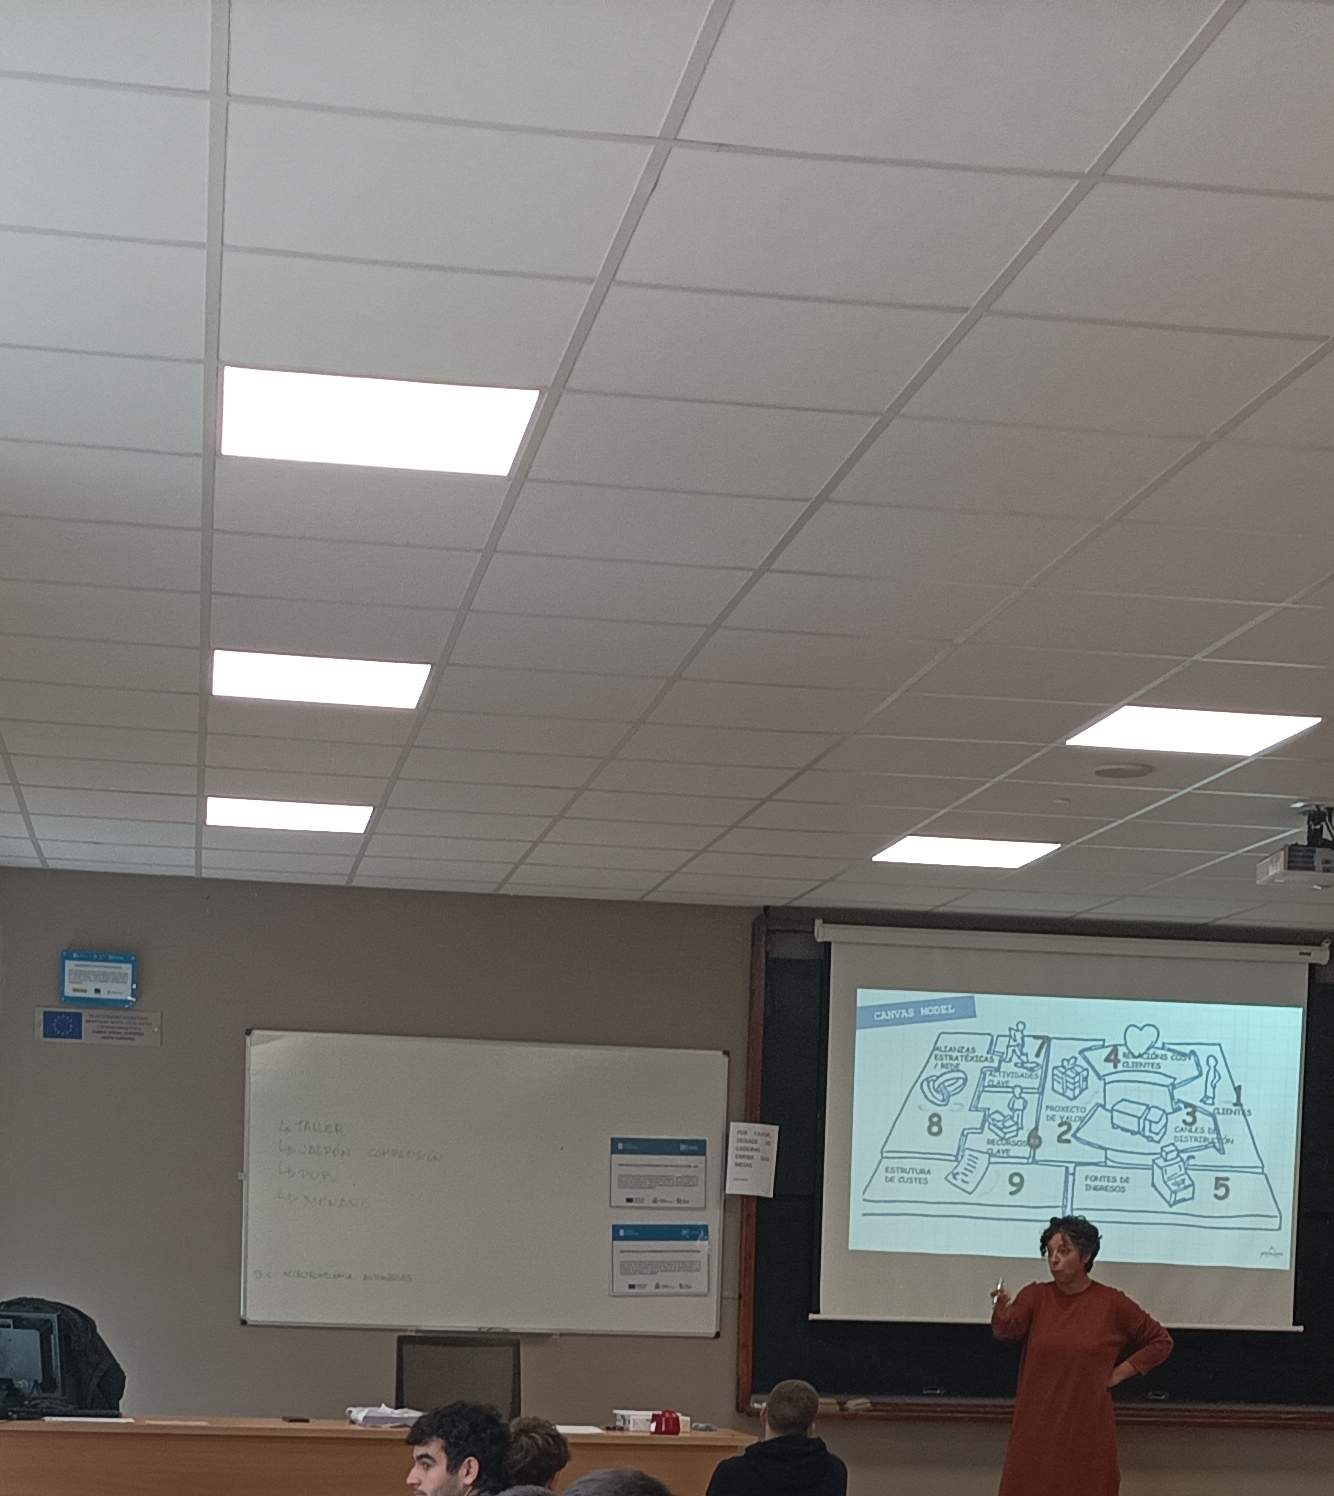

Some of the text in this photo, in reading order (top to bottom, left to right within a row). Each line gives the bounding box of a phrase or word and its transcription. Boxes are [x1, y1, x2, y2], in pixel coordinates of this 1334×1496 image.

[873, 1004, 956, 1021] CANVAS MODEL
[933, 1046, 976, 1054] ALIANZAS
[1033, 1035, 1051, 1058] 7
[934, 1054, 995, 1063] ESTRATÉXICAS
[1103, 1045, 1121, 1069] 4
[1122, 1061, 1161, 1069] CLIENTES
[988, 1071, 1039, 1080] ACTIVIDADES
[987, 1079, 1010, 1087] CLAVE
[1232, 1084, 1242, 1107] 1
[1045, 1105, 1087, 1113] PROXECTO
[1212, 1107, 1252, 1117] CLIENTES
[1046, 1114, 1056, 1122] DE
[1182, 1104, 1197, 1126] 3
[926, 1113, 943, 1137] 8
[1056, 1121, 1072, 1144] 2
[987, 1139, 1028, 1147] RECURSOS
[1174, 1135, 1234, 1144] DISTRIBUCÓN
[987, 1148, 1011, 1156] CLAVE
[884, 1167, 931, 1176] ESTRUTURA
[884, 1176, 929, 1185] DE CUSTES
[1084, 1174, 1130, 1184] FONTES DE
[1008, 1172, 1025, 1196] 9
[1084, 1184, 1127, 1193] INGRESOS
[1213, 1176, 1230, 1200] 5
